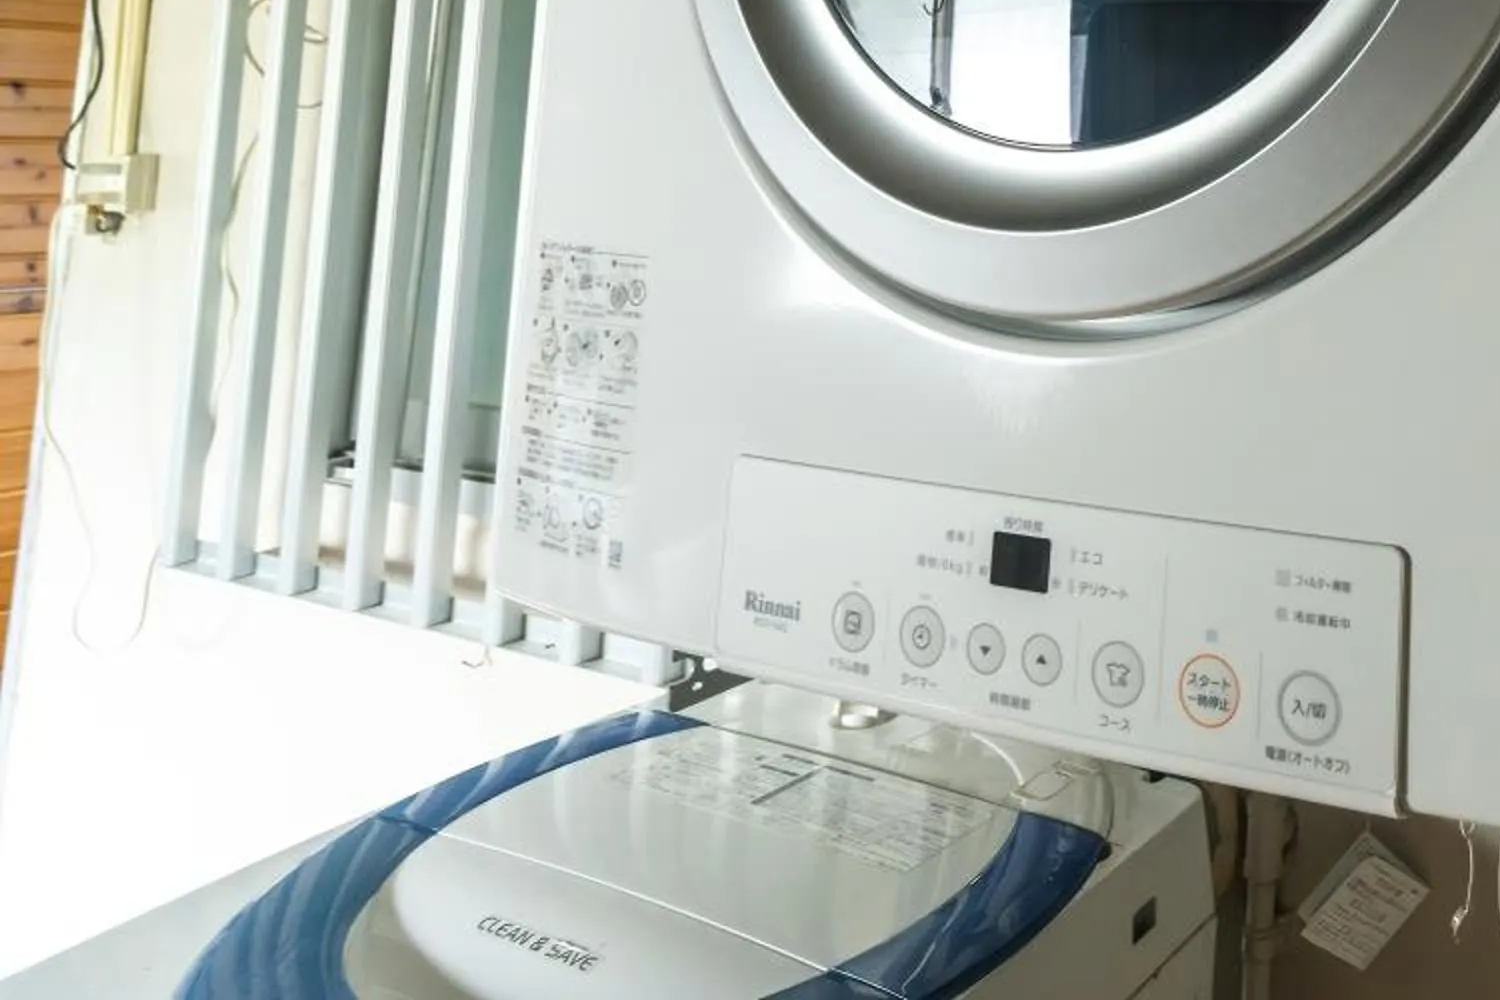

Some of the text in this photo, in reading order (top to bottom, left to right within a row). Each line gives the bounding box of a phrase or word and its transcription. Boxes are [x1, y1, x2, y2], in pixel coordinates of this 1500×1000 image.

[1079, 551, 1103, 566] エコ
[1078, 581, 1129, 601] デリケート
[744, 590, 801, 622] Rinnai
[900, 672, 938, 689] タイマー
[1186, 672, 1232, 691] スタート
[1186, 693, 1231, 712] 一時停止
[1291, 699, 1327, 721] 入/切
[1098, 713, 1131, 733] コース
[476, 916, 599, 972] CLEAN & SAVE
